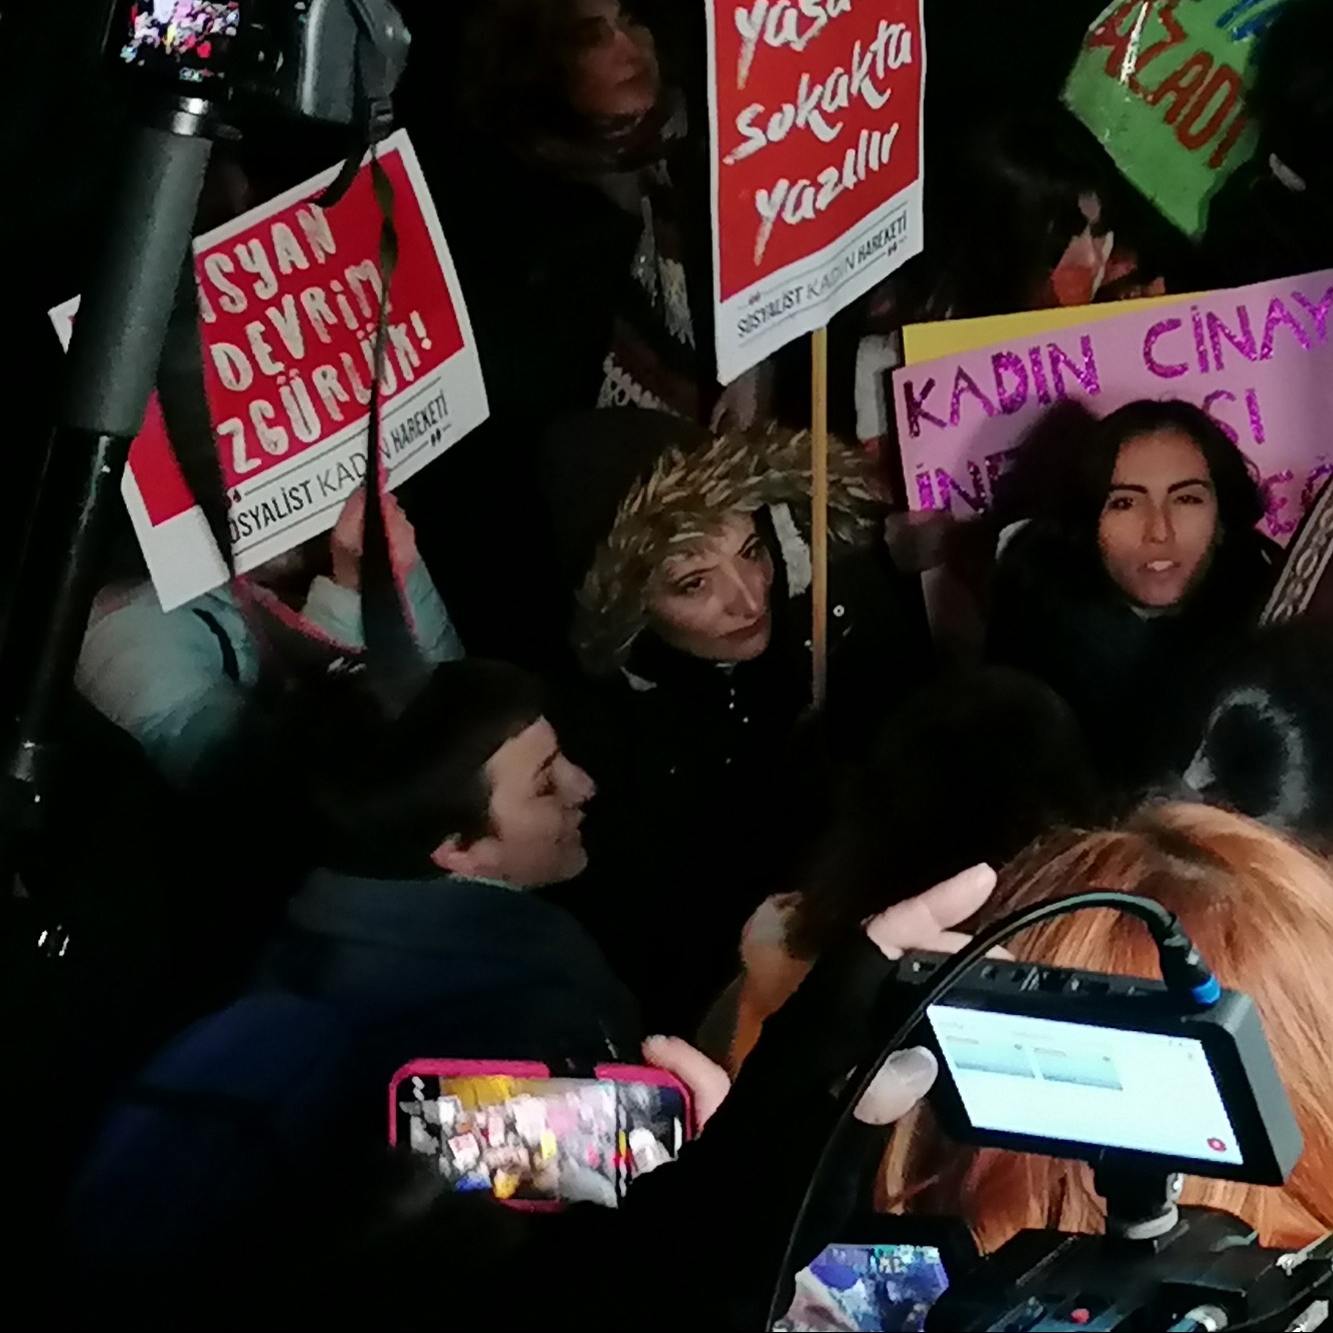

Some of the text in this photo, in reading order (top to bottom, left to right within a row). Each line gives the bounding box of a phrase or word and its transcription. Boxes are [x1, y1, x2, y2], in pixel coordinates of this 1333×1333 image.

[217, 310, 432, 475] ZGÜRLÜK!
[904, 334, 1100, 437] KADIN
[229, 479, 314, 544] OSYALİST
[318, 433, 391, 493] KADN
